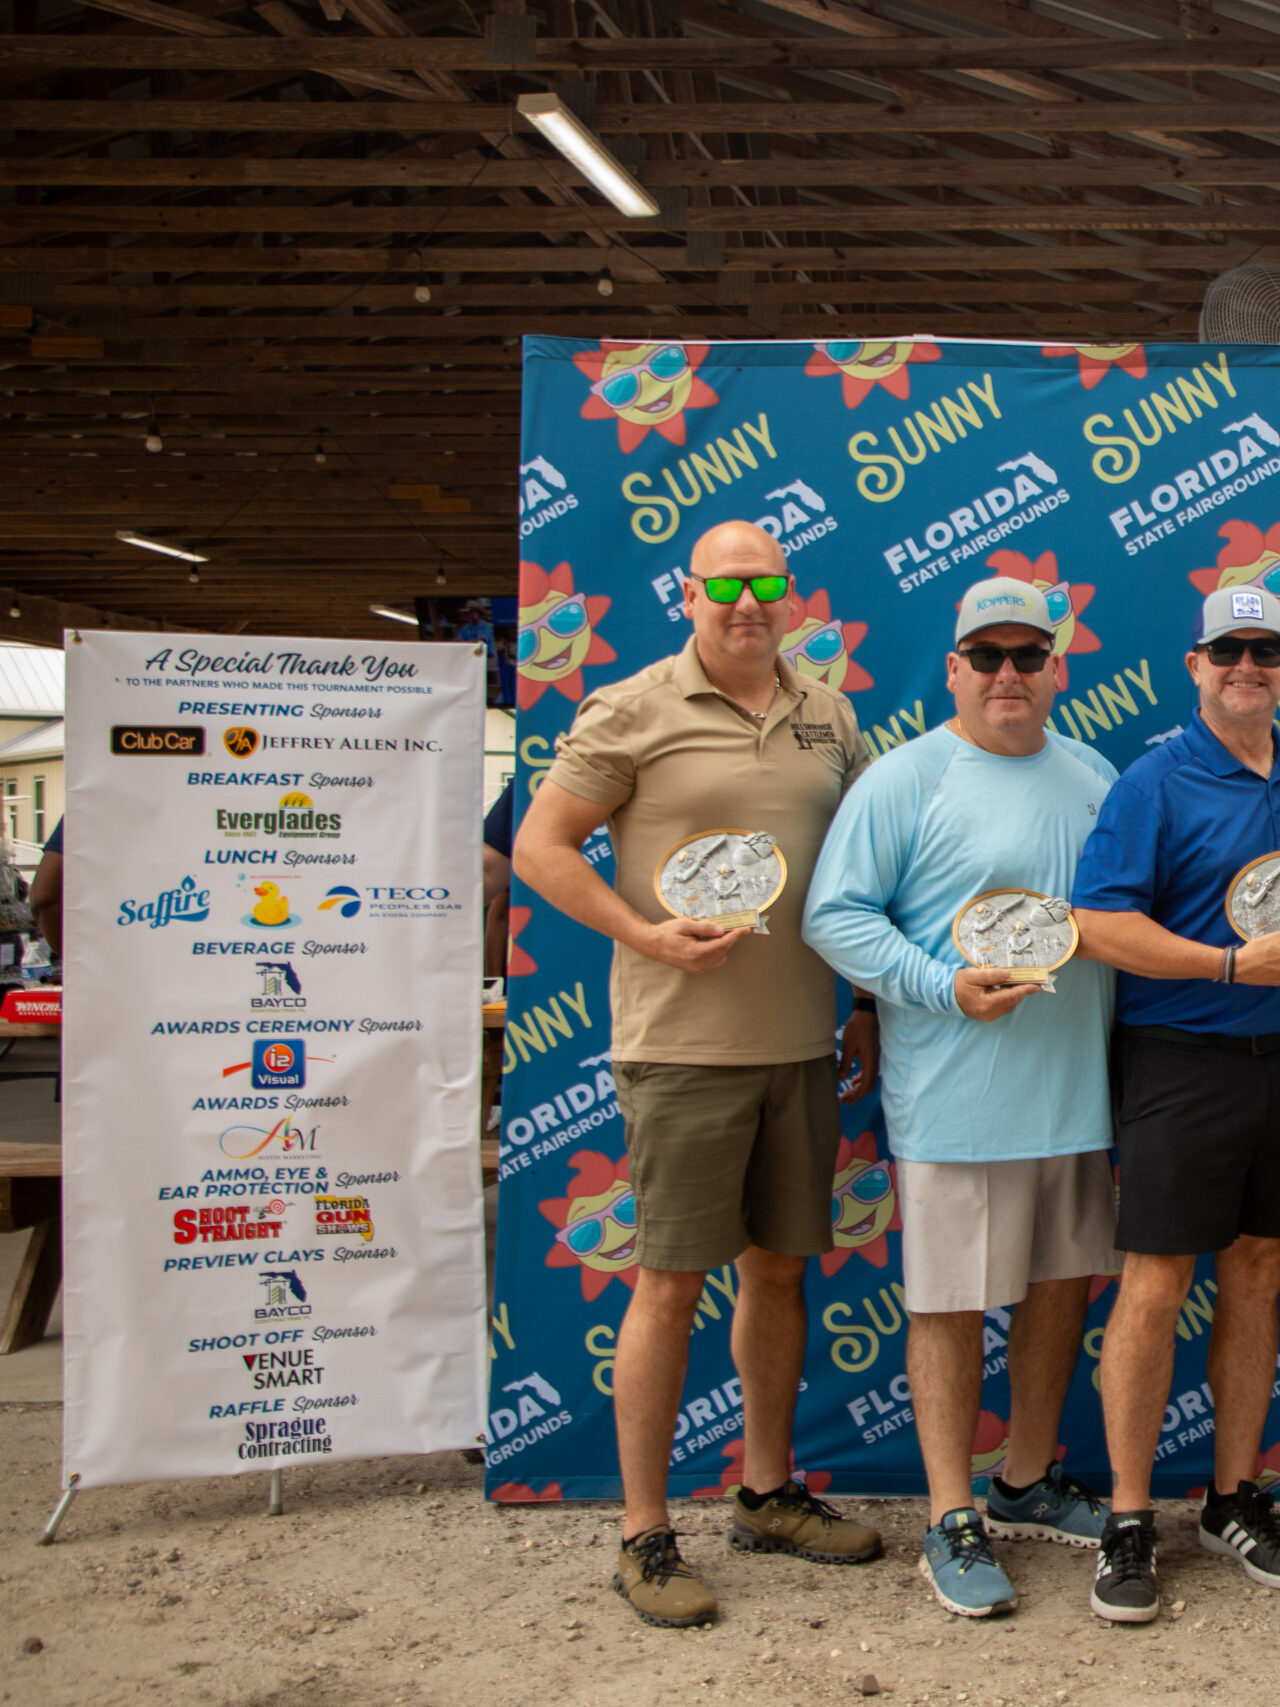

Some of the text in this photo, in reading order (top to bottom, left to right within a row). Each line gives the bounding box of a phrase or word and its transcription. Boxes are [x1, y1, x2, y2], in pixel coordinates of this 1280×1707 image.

[1082, 353, 1237, 484] SUNNY
[847, 373, 1003, 502] SUNNY
[622, 412, 779, 544] SUNNY
[1109, 434, 1267, 538] FLORIDA
[883, 472, 1044, 576] FLORIDA
[899, 490, 1071, 594] STATE FAIRGROUNDS
[1124, 526, 1176, 556] STATE
[976, 595, 1026, 612] KOPPERS
[145, 649, 418, 682] A Special Thank You
[126, 678, 140, 686] TO
[143, 678, 162, 686] THE
[166, 679, 219, 688] PARTNERS
[253, 682, 282, 690] MADE
[312, 684, 384, 692] TOURNAMENT
[387, 686, 432, 694] POSSIBLE
[179, 702, 381, 720] PRESENTING Sponsors
[121, 731, 196, 750] Club Car
[263, 735, 442, 752] JEFFREY ALLEN INC.
[188, 772, 373, 789] BREAKFAST Sponsor
[216, 809, 341, 834] Everglades
[205, 850, 356, 868] LUNCH Sponsors
[366, 888, 450, 899] TECO
[117, 889, 210, 929] Saffire
[192, 940, 366, 958] BEVERAGE Sponsor
[251, 998, 306, 1008] BAYCO
[151, 1018, 421, 1035] AWARDS CEREMONY Sponsor
[257, 1074, 299, 1085] Visual
[158, 1171, 399, 1200] EAR PROTECTION Sponsor
[200, 1167, 328, 1182] AMMO, EYE &
[164, 1247, 396, 1272] PREVIEW CLAYS Sponsor
[188, 1326, 375, 1352] SHOOT OFF Sponsor
[254, 1367, 324, 1390] SMART
[210, 1394, 357, 1418] RAFFLE Sponsor
[245, 1418, 326, 1443] Sprague
[238, 1435, 332, 1459] Contracting
